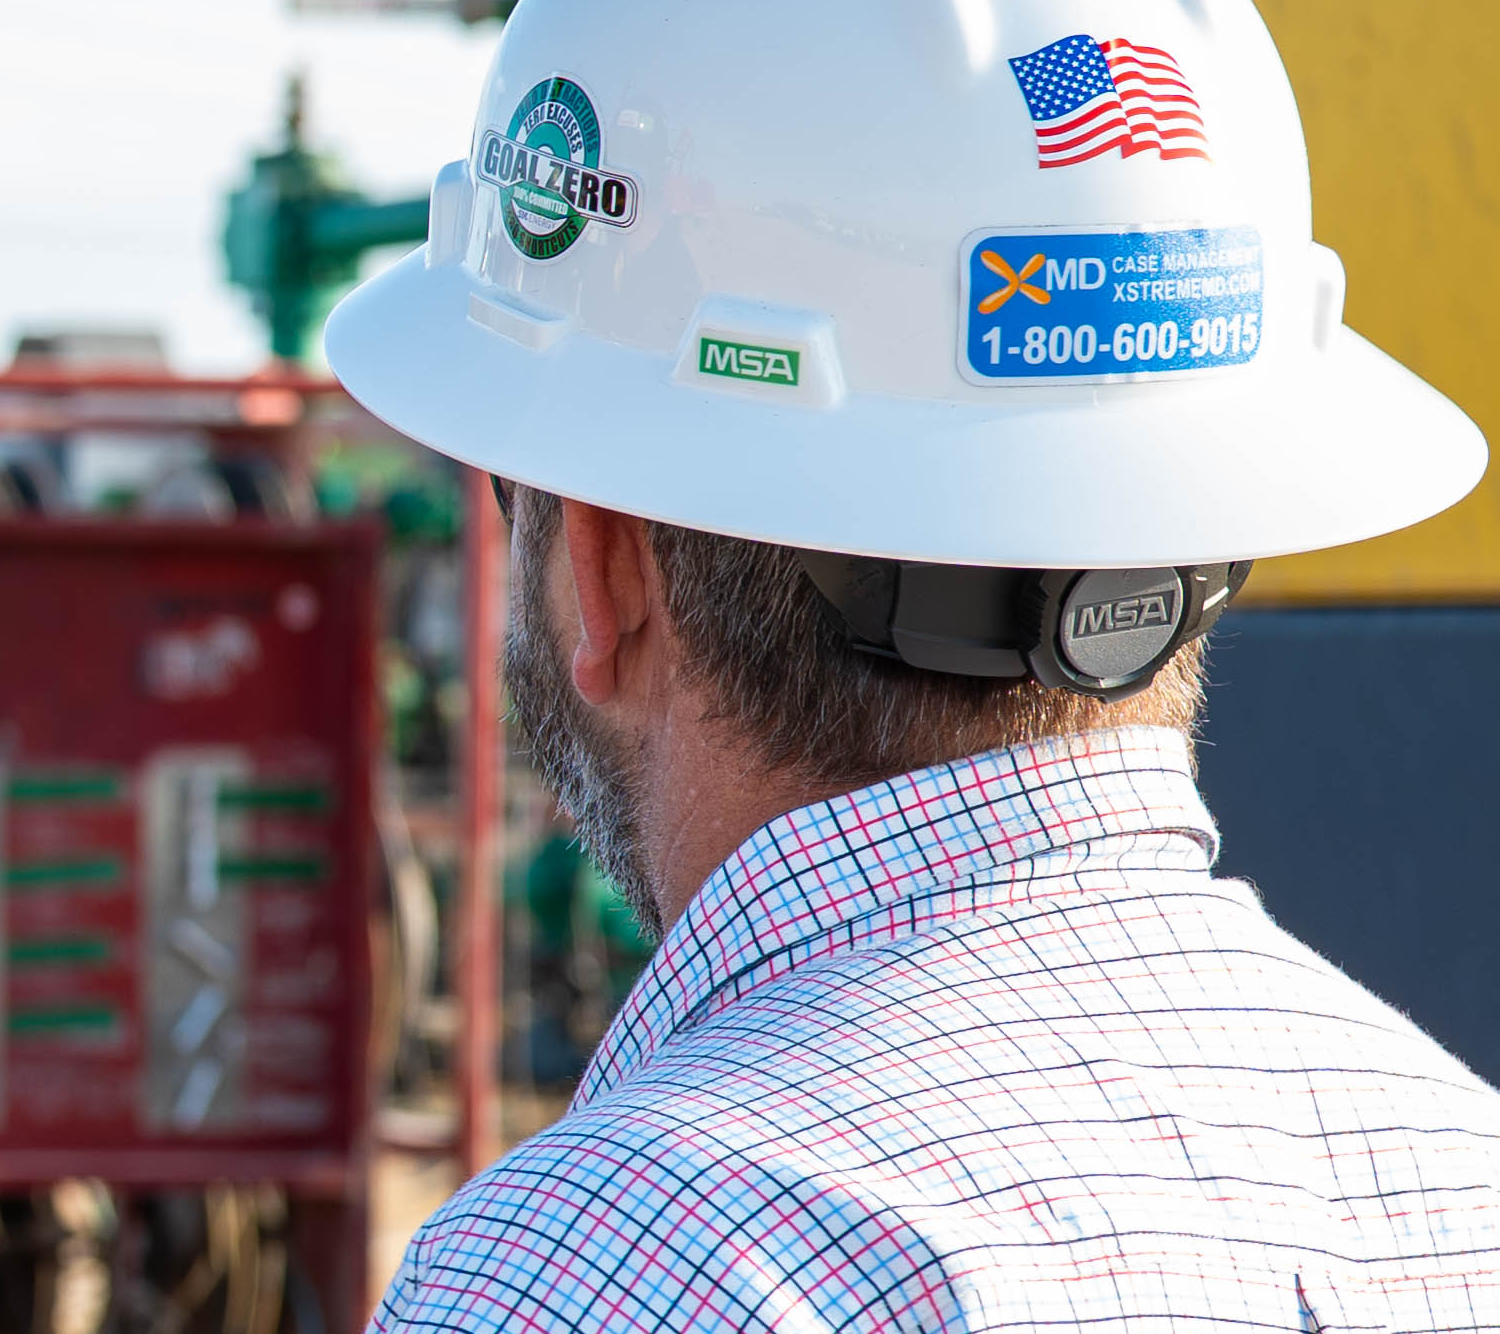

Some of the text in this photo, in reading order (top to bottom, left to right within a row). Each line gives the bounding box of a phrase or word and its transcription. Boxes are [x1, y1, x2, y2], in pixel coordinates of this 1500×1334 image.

[540, 80, 598, 153] DSTRACTIONS
[546, 102, 583, 154] EXCUSES
[484, 137, 627, 218] GOAL ZERO
[519, 220, 579, 255] SHORTCUTS
[1112, 255, 1159, 274] CASE
[1163, 245, 1259, 271] MANAGEET
[981, 314, 1260, 365] 1-800-600-9015
[704, 344, 795, 381] MSA
[1077, 596, 1169, 636] MSA
